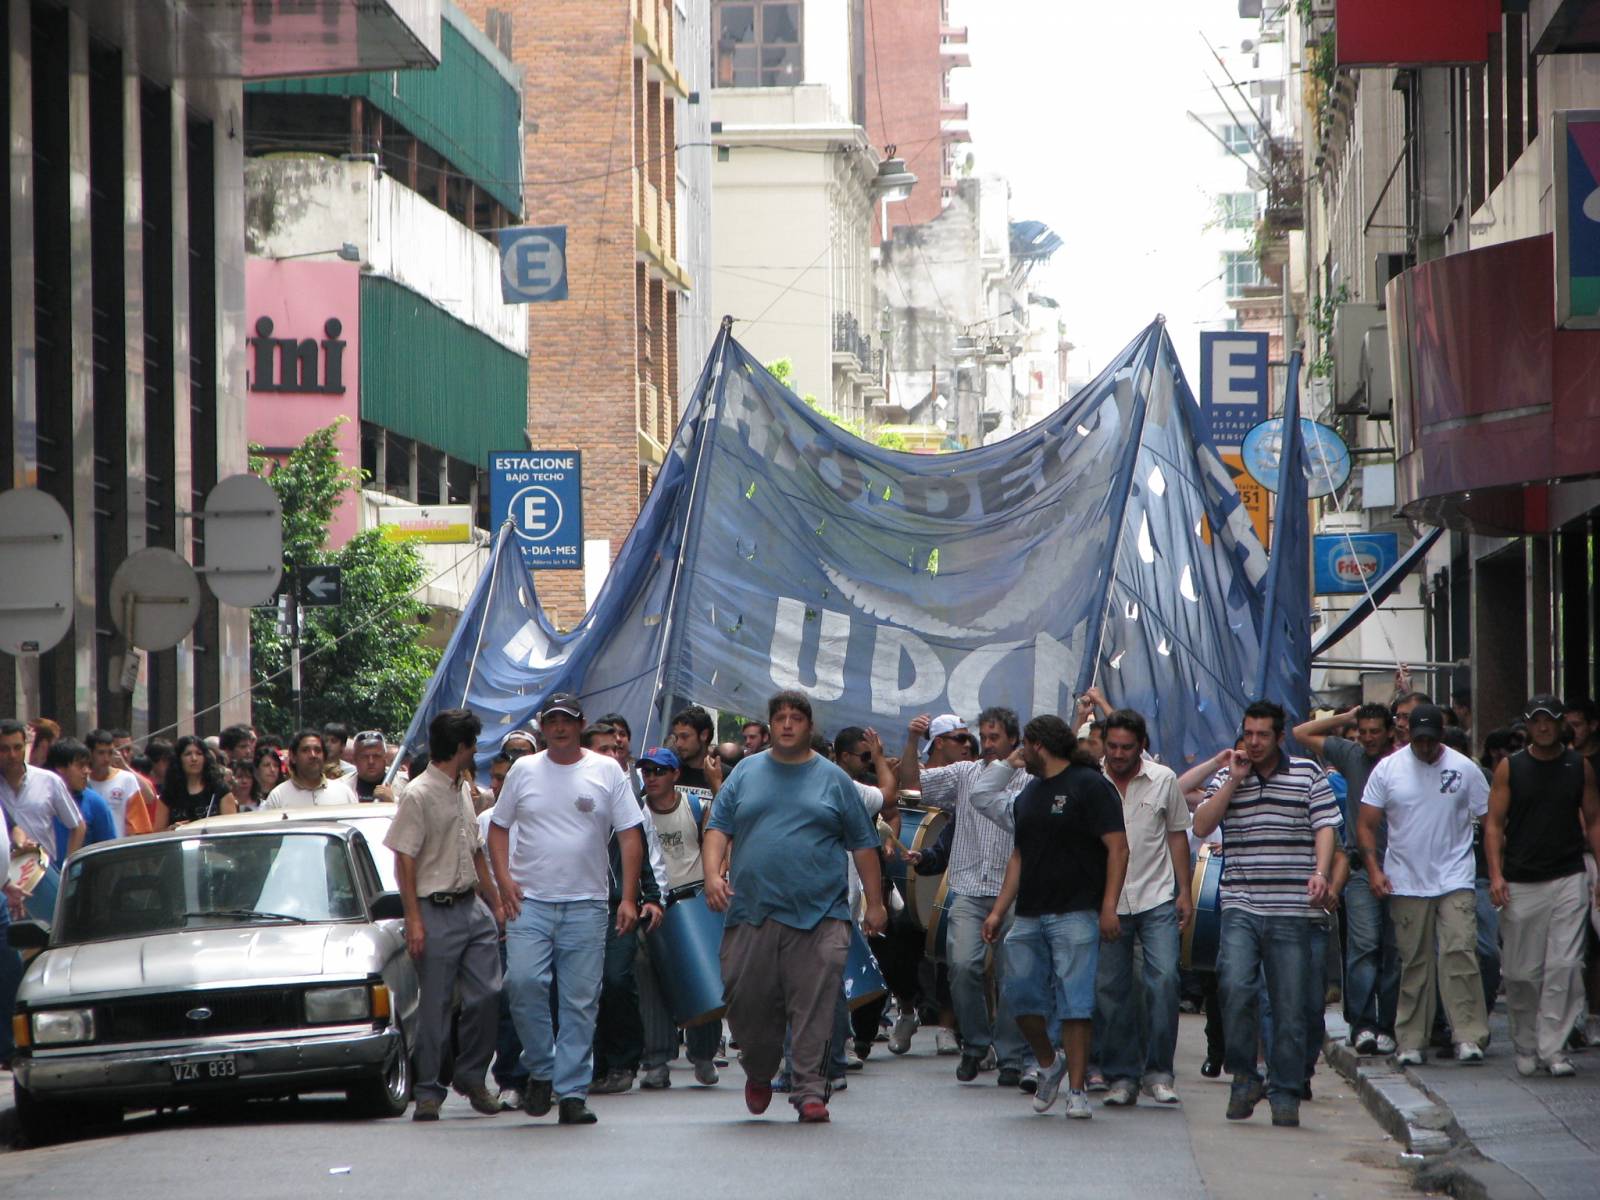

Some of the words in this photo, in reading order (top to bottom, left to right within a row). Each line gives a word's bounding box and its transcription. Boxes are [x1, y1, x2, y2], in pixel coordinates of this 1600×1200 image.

[516, 242, 552, 288] E
[246, 316, 347, 394] ini
[1212, 340, 1259, 404] E
[495, 457, 574, 470] ESTACIONE
[505, 473, 529, 483] BAJO
[532, 473, 565, 481] TECHO
[524, 496, 546, 530] E
[173, 1063, 200, 1080] VZK
[208, 1060, 236, 1077] 833
